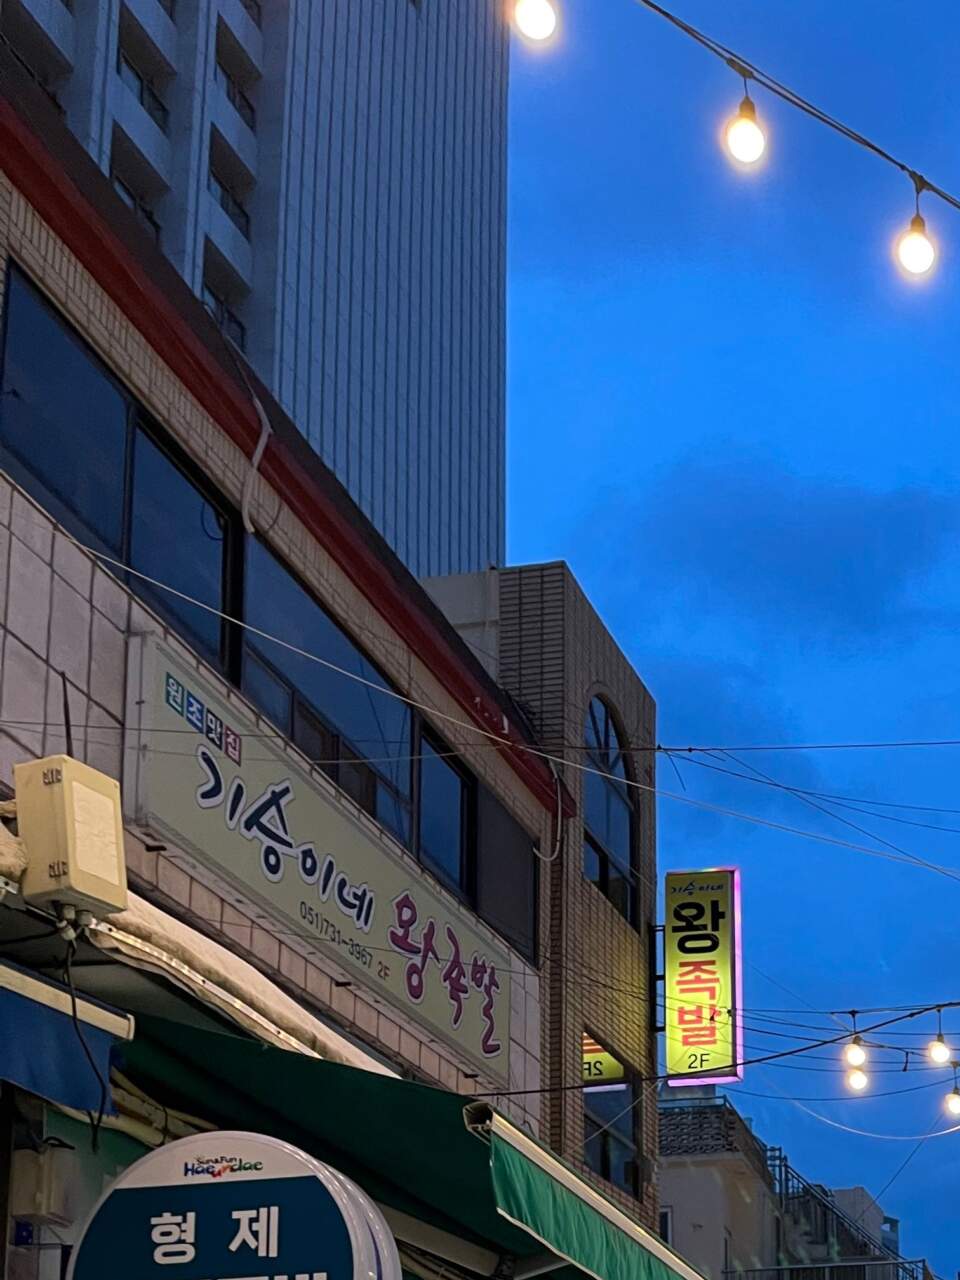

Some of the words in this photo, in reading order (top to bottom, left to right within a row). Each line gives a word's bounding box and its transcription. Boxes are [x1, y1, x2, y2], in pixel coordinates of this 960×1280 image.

[299, 900, 374, 970] 051)731-3967
[376, 960, 391, 982] 2F
[388, 892, 502, 1056] 왕족발
[671, 899, 726, 1048] 왕족발
[687, 1053, 710, 1070] 2F
